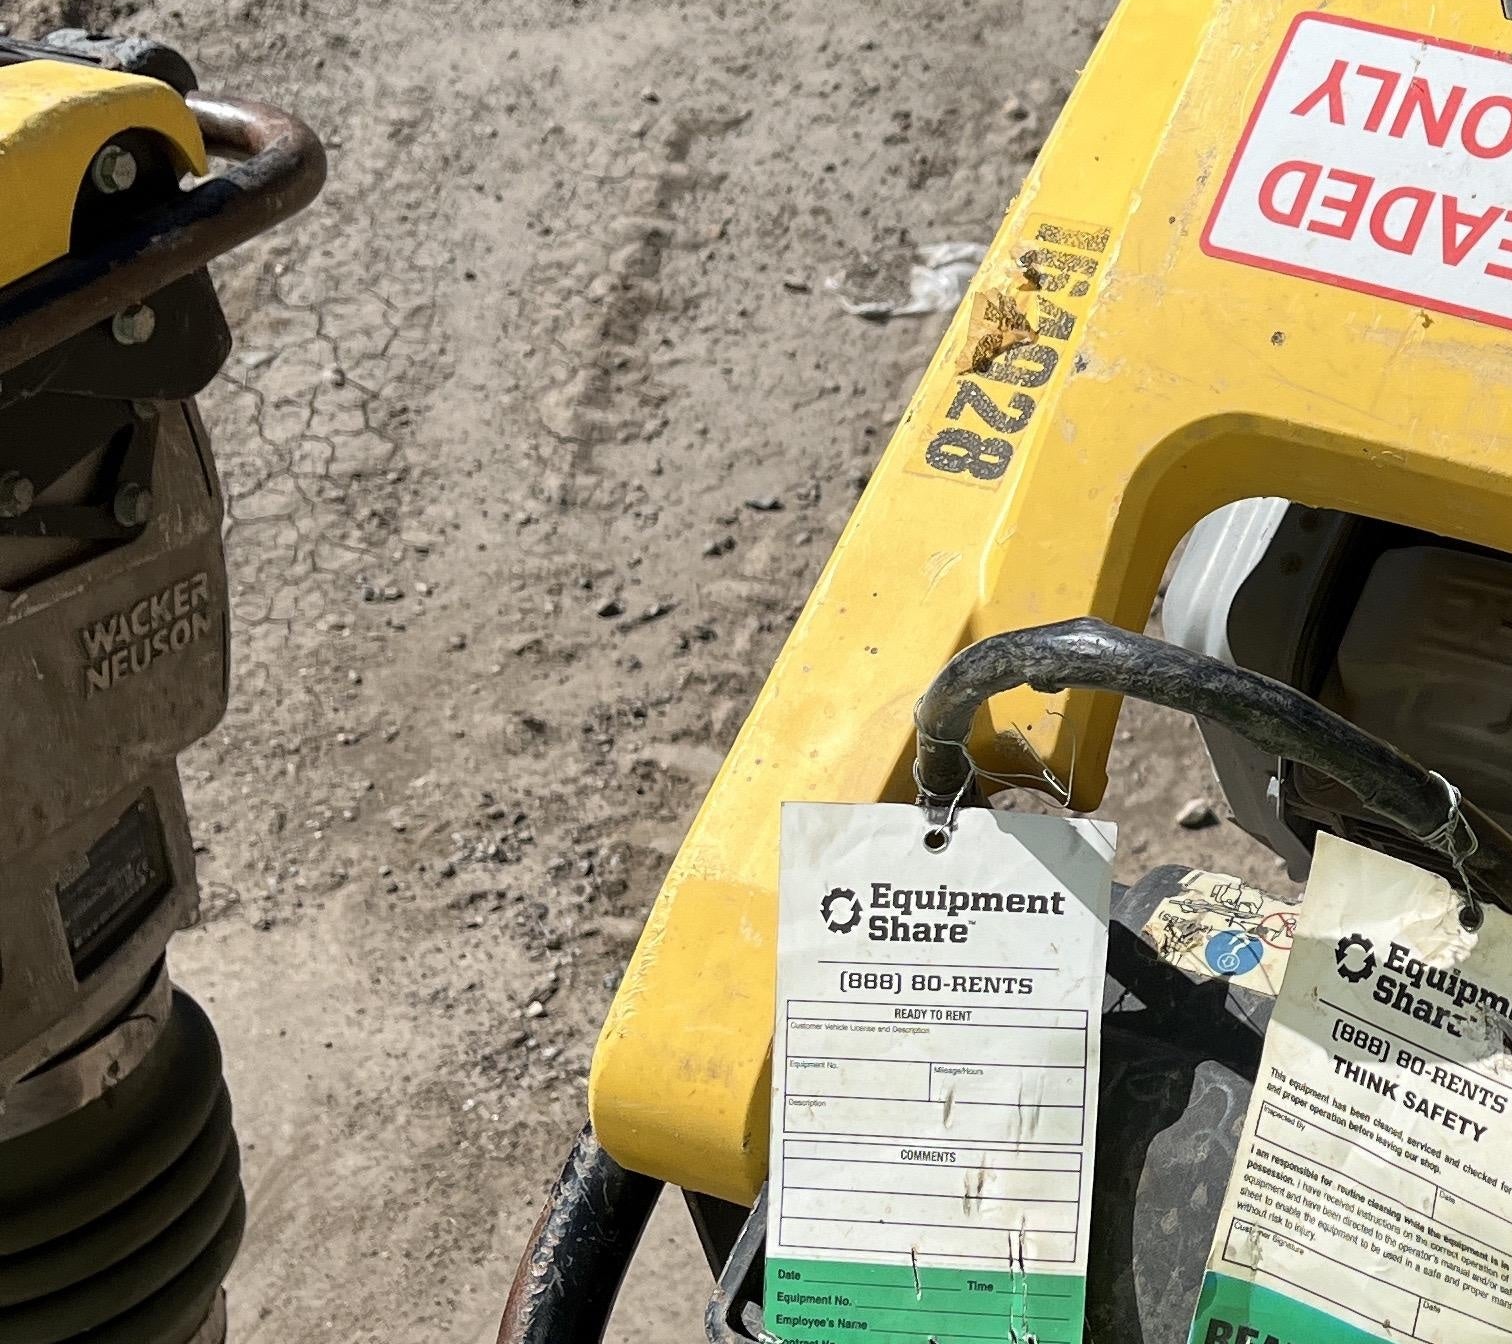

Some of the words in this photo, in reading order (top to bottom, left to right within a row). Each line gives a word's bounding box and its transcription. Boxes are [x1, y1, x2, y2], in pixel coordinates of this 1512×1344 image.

[81, 572, 208, 657] WACKER
[86, 612, 211, 698] NEUSON
[869, 883, 1065, 917] Equipment
[868, 916, 969, 943] Share
[840, 971, 901, 994] (888)
[912, 975, 1033, 994] 80-RENTS
[895, 1008, 927, 1020] READY
[930, 1010, 942, 1020] TO
[946, 1011, 972, 1021] RENT
[790, 1022, 822, 1030] Customer
[824, 1023, 848, 1031] Vehicle
[892, 1026, 930, 1034] Description
[789, 1060, 825, 1068] Equipment
[827, 1061, 839, 1069] No.
[1331, 1018, 1392, 1065] (888)
[1395, 1046, 1508, 1116] 80-RENTS
[789, 1099, 826, 1108] Description
[1332, 1055, 1399, 1109] THINK
[1402, 1088, 1487, 1143] SAFETY
[1266, 1082, 1282, 1095] and
[1281, 1090, 1308, 1107] proper
[1309, 1104, 1347, 1127] operation
[1348, 1120, 1374, 1139] before
[1375, 1133, 1403, 1156] leaving
[1404, 1150, 1418, 1162] our
[1420, 1158, 1441, 1174] shop.
[1271, 1066, 1286, 1083] This
[1289, 1078, 1330, 1103] equipment
[1331, 1097, 1347, 1112] has
[1349, 1106, 1371, 1122] been
[1373, 1118, 1403, 1142] cleaned,
[1406, 1136, 1442, 1158] serviced
[1444, 1154, 1460, 1168] and
[1462, 1164, 1498, 1187] checked
[1500, 1181, 1512, 1194] for
[901, 1149, 956, 1162] COMMENTS
[1439, 1190, 1456, 1204] Date
[1255, 1148, 1269, 1159] am
[1271, 1155, 1318, 1181] responsible
[1320, 1174, 1333, 1187] for
[1337, 1184, 1366, 1203] routine
[1367, 1198, 1402, 1222] cleaning
[1404, 1216, 1425, 1233] while
[1427, 1226, 1441, 1239] the
[1443, 1235, 1488, 1261] equipment
[1490, 1255, 1499, 1266] is
[1500, 1260, 1510, 1271] in
[1237, 1201, 1267, 1218] without
[1268, 1213, 1283, 1225] risk
[1284, 1218, 1293, 1230] to
[1294, 1223, 1315, 1241] injury.
[778, 1269, 801, 1280] Date
[967, 1281, 993, 1292] Time
[777, 1292, 832, 1305] Equipment
[835, 1295, 852, 1306] No.
[1422, 1299, 1441, 1314] Date
[776, 1315, 834, 1328] Employee's
[838, 1319, 867, 1330] Name
